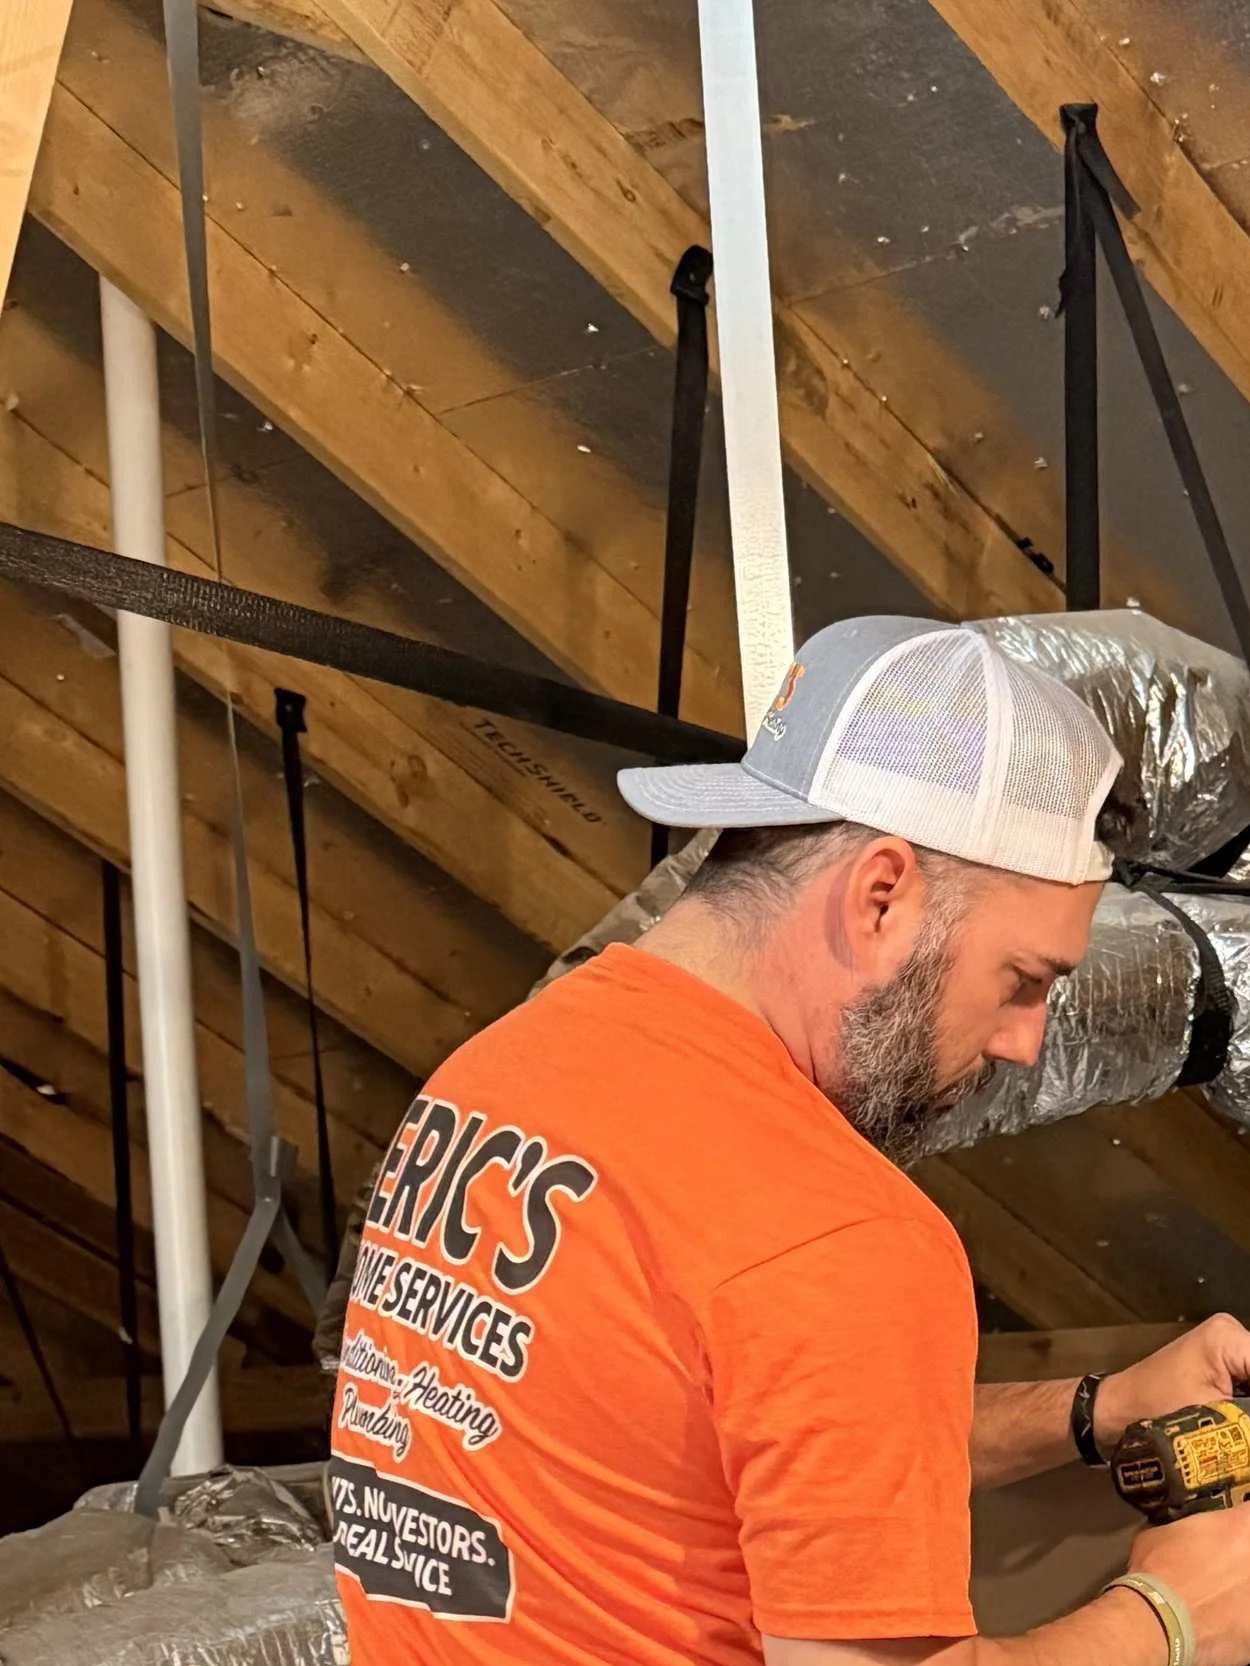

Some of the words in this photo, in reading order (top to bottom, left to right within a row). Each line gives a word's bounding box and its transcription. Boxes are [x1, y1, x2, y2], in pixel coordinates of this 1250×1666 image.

[474, 718, 602, 822] TECHSHIELD
[366, 1094, 598, 1296] ERIC'S
[352, 1240, 386, 1312] OME
[382, 1260, 534, 1384] SERVICES
[403, 1365, 499, 1446] Heating
